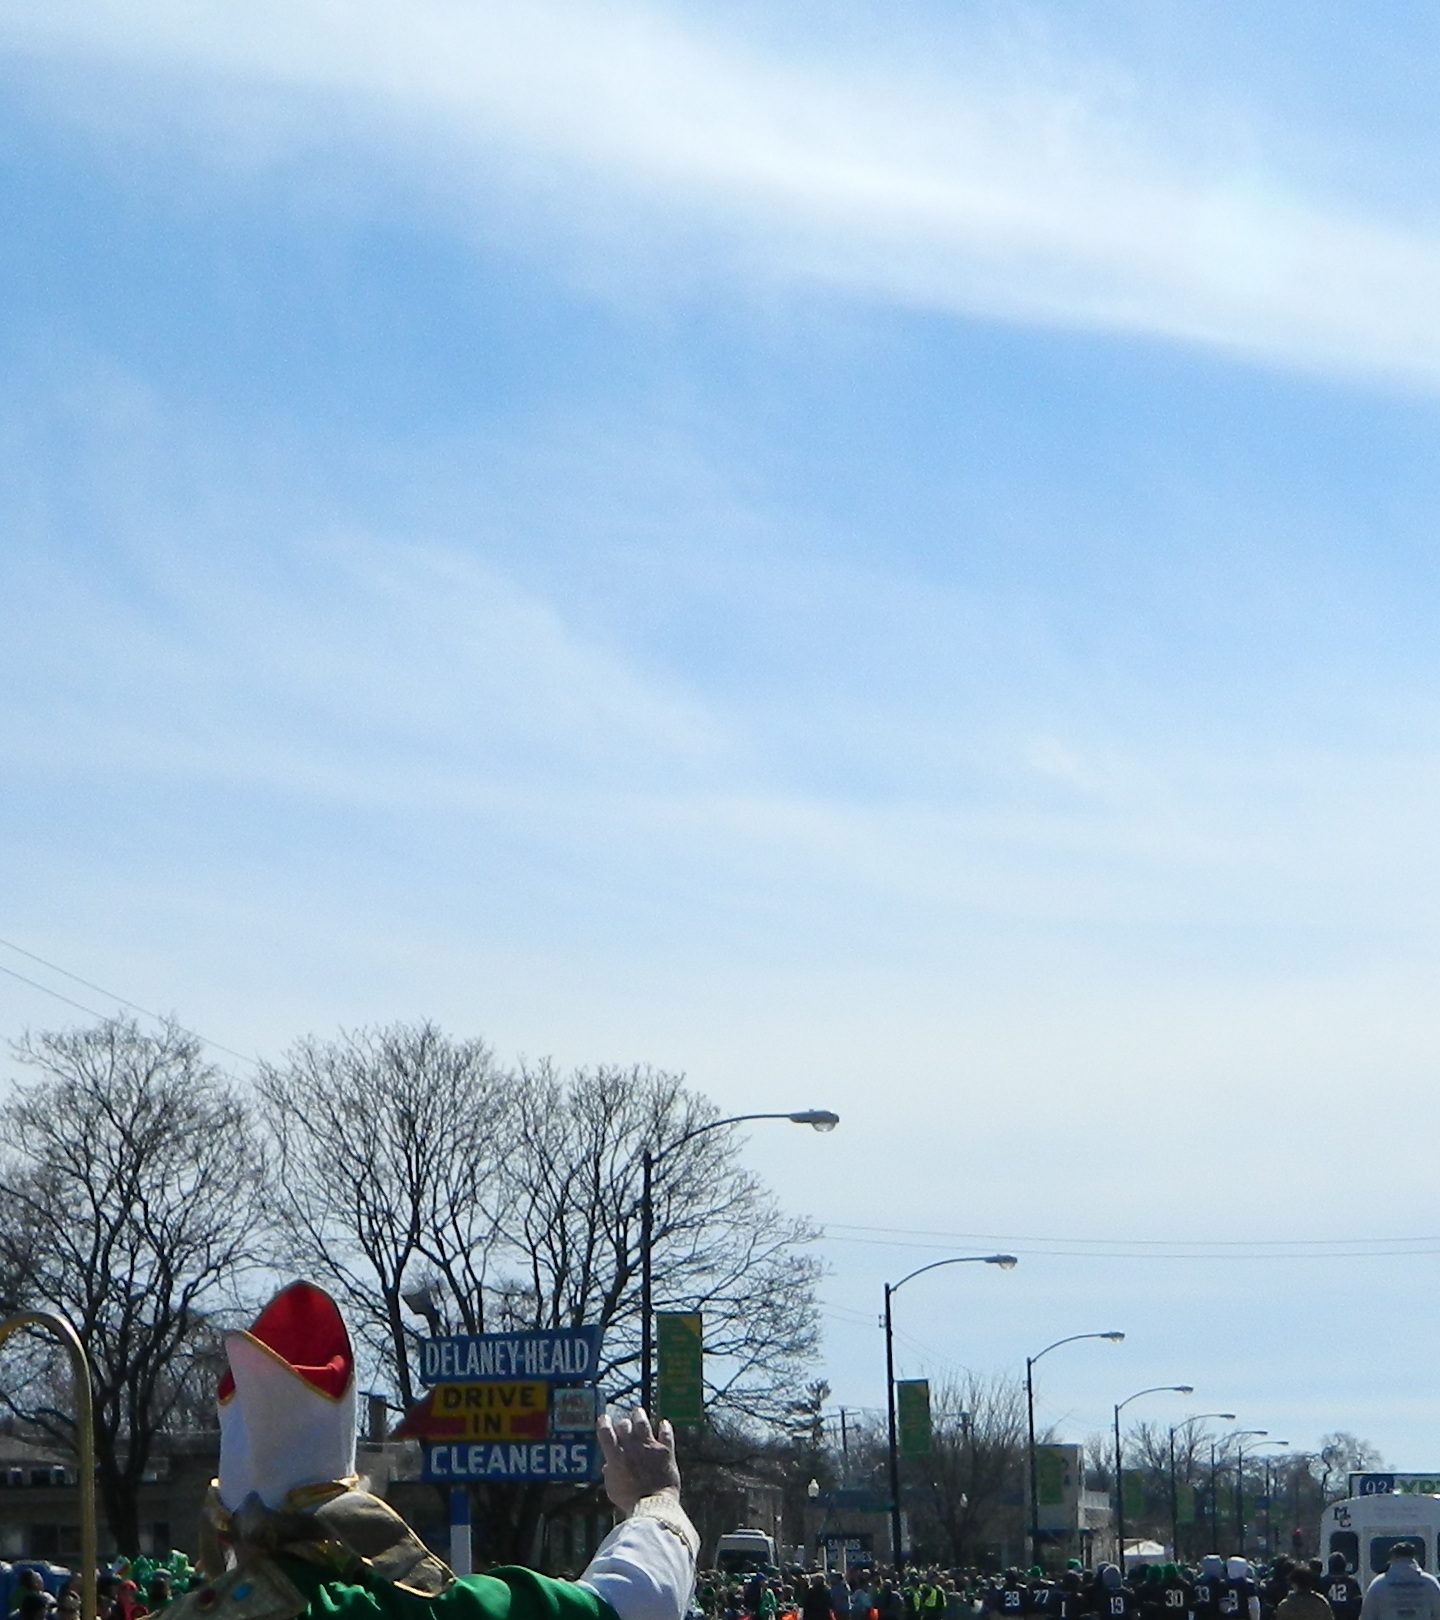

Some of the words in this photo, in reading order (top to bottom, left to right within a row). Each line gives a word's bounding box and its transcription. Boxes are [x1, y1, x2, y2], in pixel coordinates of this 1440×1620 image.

[443, 1386, 536, 1410] DRIVE
[473, 1414, 502, 1434] IN
[430, 1444, 588, 1475] CLEANERS
[1165, 1589, 1184, 1607] 30
[1328, 1584, 1347, 1602] 42
